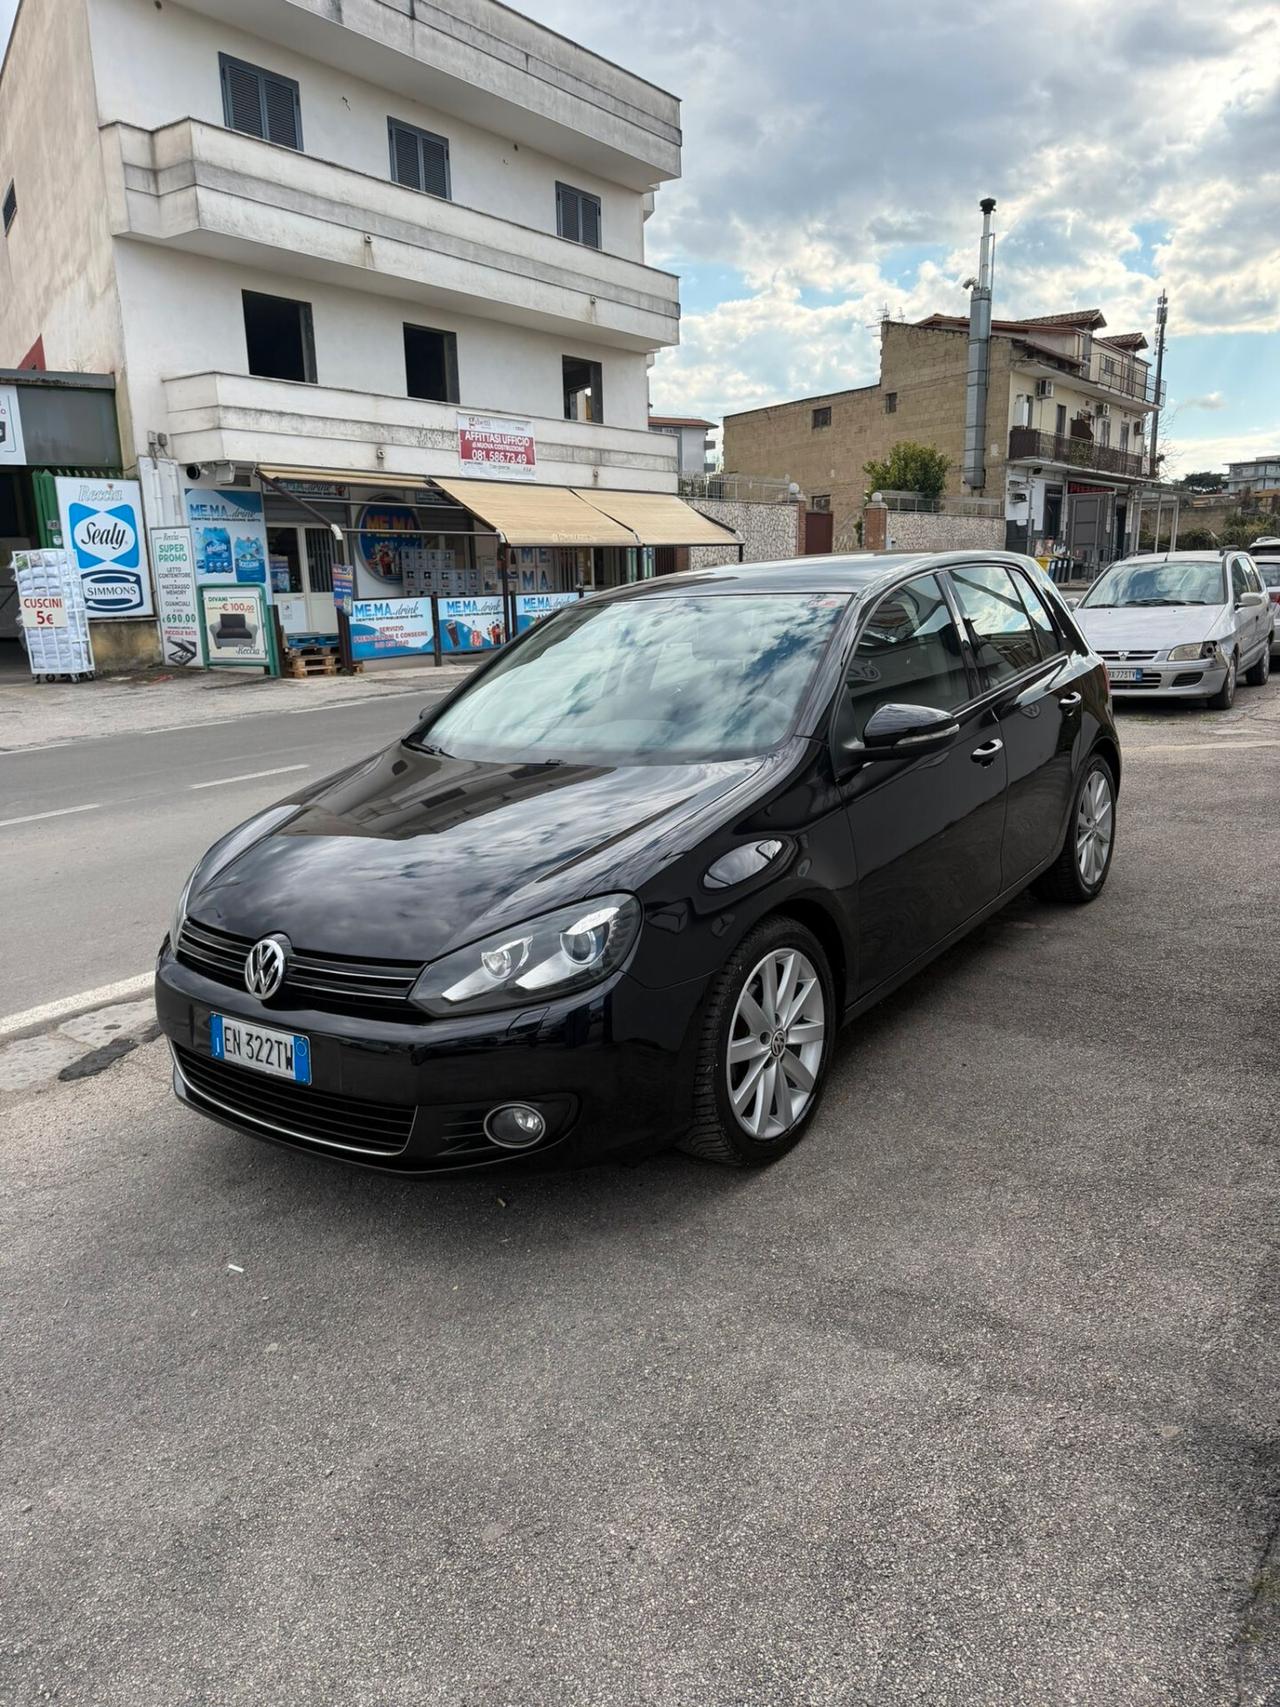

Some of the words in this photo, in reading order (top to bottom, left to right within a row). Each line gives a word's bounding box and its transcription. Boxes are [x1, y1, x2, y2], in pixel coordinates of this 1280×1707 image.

[465, 431, 501, 444] AFFITTASI
[502, 435, 530, 447] UFFICIO
[81, 521, 126, 550] Sealy
[159, 544, 185, 553] SUPER
[158, 553, 187, 562] PROMO
[87, 585, 137, 596] SIMMONS
[23, 598, 62, 609] CUSCINI
[446, 600, 478, 613] ME.MA
[354, 603, 392, 618] ME.MA
[36, 610, 54, 625] 5€
[379, 625, 404, 633] SERVIZIO
[223, 1026, 242, 1057] EN
[245, 1032, 294, 1071] 322TW
